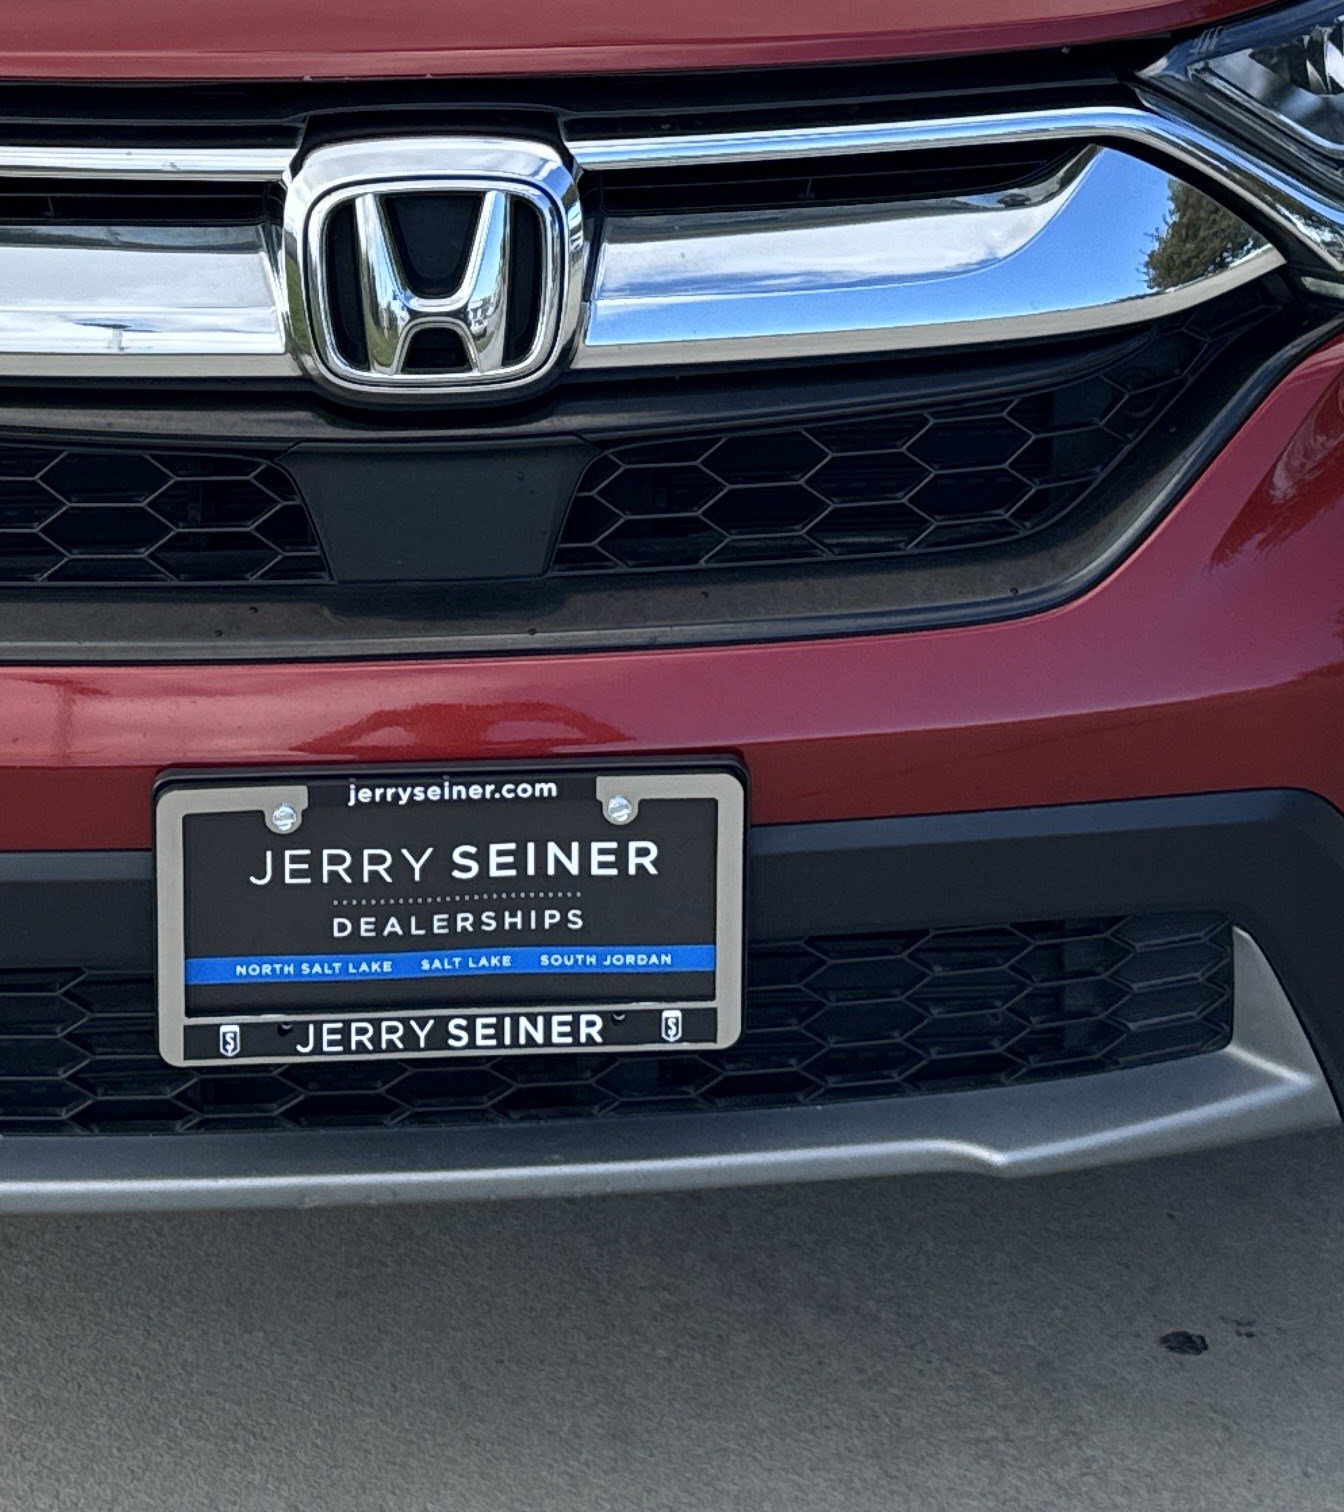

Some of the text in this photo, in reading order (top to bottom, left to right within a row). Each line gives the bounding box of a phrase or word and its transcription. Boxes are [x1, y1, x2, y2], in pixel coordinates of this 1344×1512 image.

[347, 776, 558, 807] jerryseiner.com
[249, 840, 659, 886] JERRY SEINER
[333, 909, 585, 938] DEALERSHIPS
[235, 953, 672, 976] NORTH SALT LAKE SALT LAKE SOUTH JORDAN
[296, 1013, 603, 1053] JERRY SEINER
